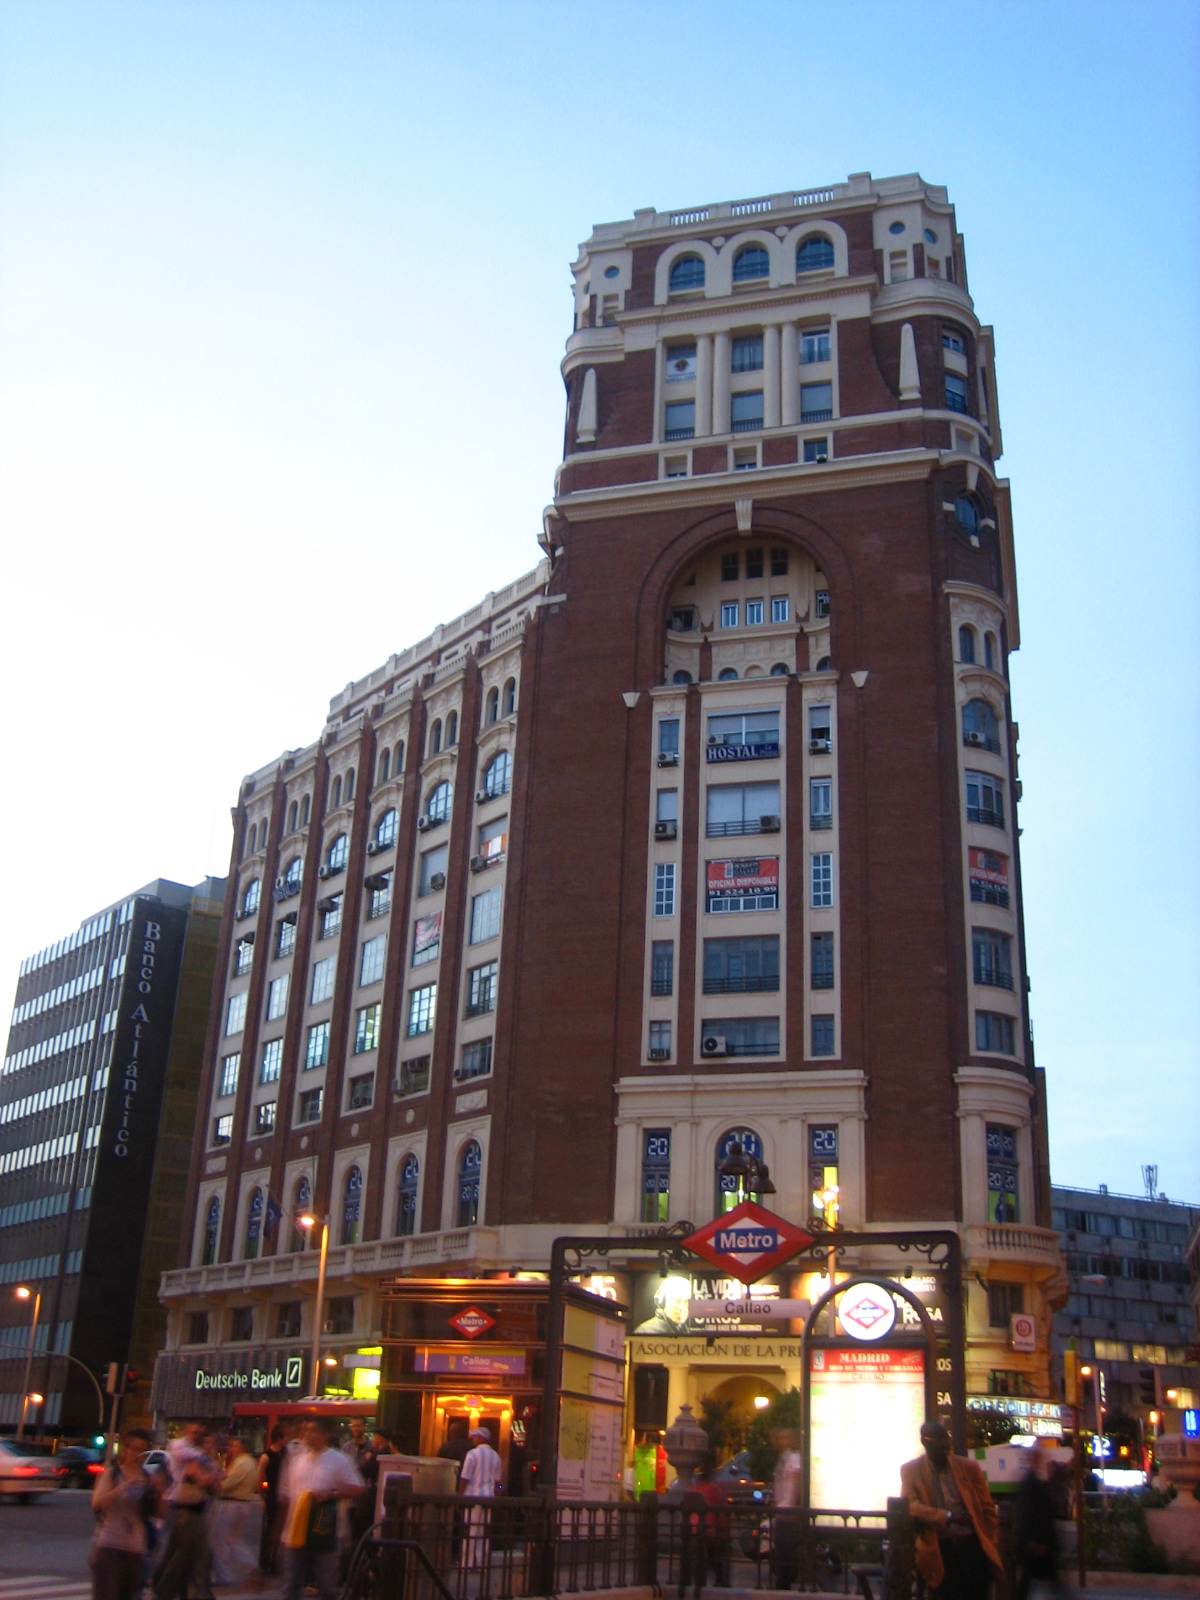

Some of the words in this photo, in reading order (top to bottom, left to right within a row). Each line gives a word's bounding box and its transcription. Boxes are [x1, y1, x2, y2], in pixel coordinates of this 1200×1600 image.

[708, 745, 758, 760] HOSTAL
[709, 879, 735, 888] OFICINA
[736, 876, 776, 886] DISPONIBLE
[138, 920, 162, 994] Banco
[114, 1002, 150, 1158] Atlántico
[648, 1138, 668, 1155] 20
[814, 1130, 836, 1149] 20
[721, 1175, 736, 1188] 20
[720, 1231, 774, 1249] Metro
[693, 1278, 709, 1294] LA
[724, 1301, 772, 1315] Callao
[460, 1317, 484, 1326] Metro
[733, 1344, 751, 1357] DE
[756, 1345, 775, 1358] LA
[839, 1352, 891, 1363] MADRID
[462, 1355, 491, 1366] Callao
[195, 1369, 248, 1389] Deutsche
[251, 1367, 283, 1388] Bank
[852, 1373, 885, 1381] CALLAO
